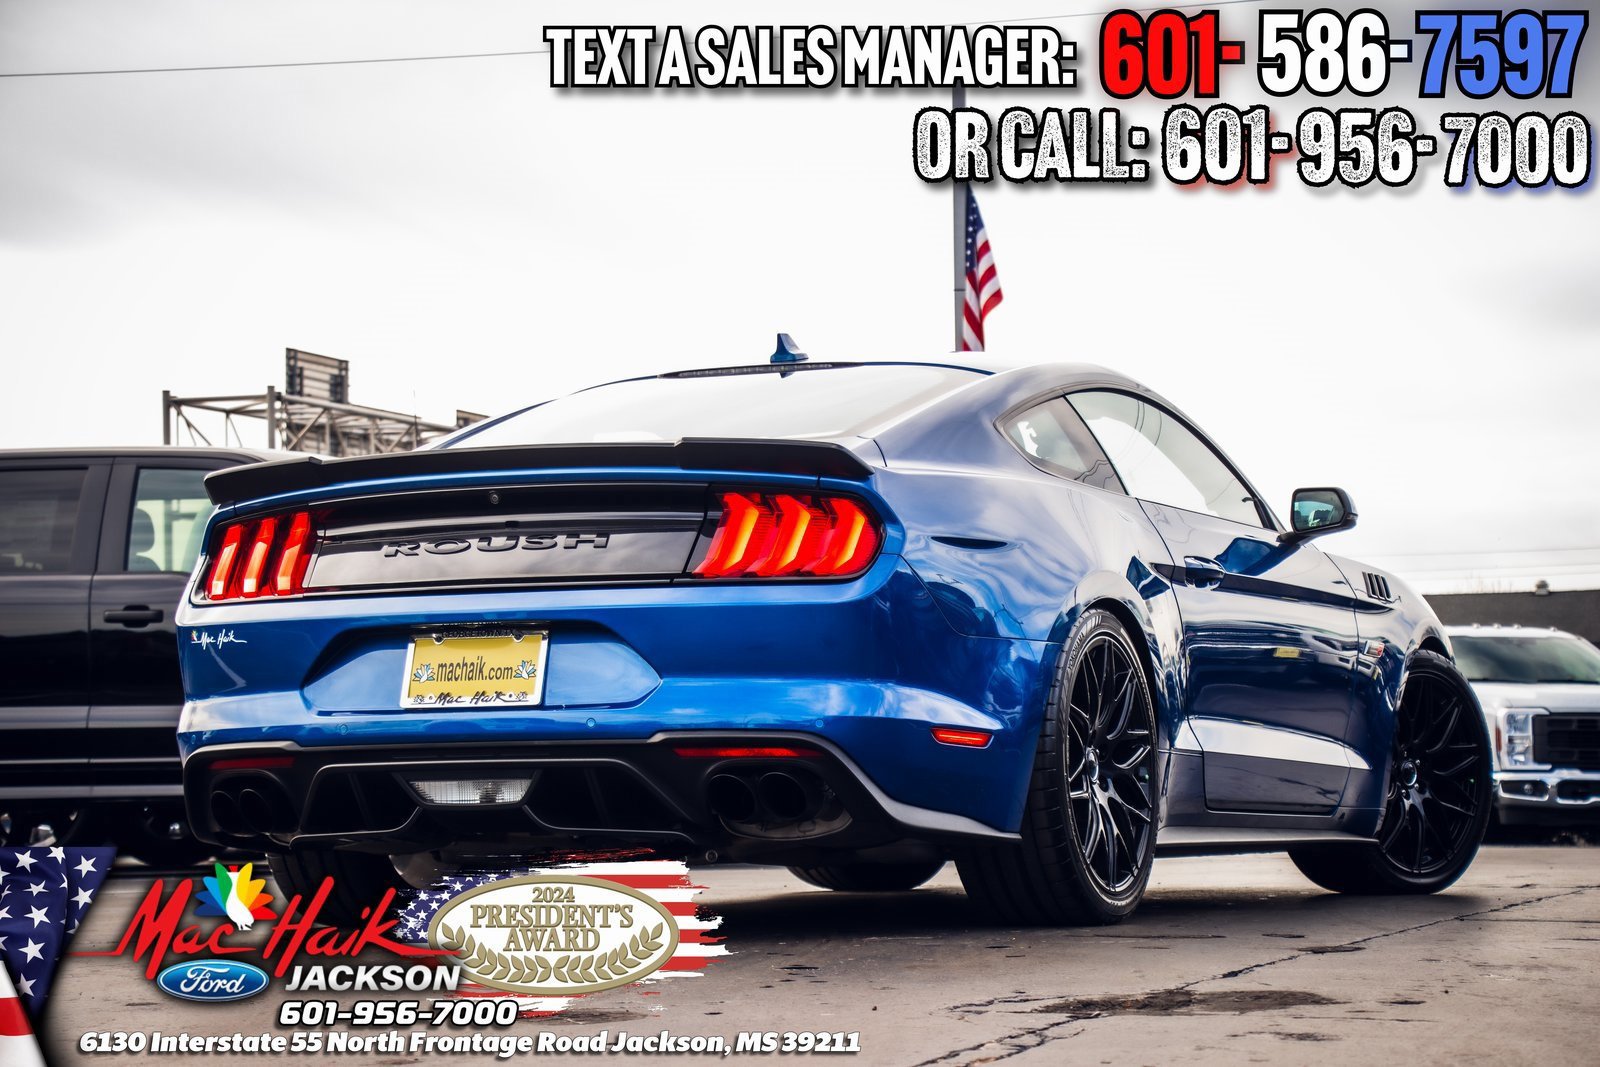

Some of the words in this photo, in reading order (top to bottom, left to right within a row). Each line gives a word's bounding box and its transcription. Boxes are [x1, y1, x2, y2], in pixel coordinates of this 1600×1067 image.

[384, 532, 610, 559] ROUSH
[200, 631, 216, 650] Mac
[436, 656, 514, 682] machaik.com
[433, 691, 467, 706] Mac
[470, 690, 515, 705] Haik
